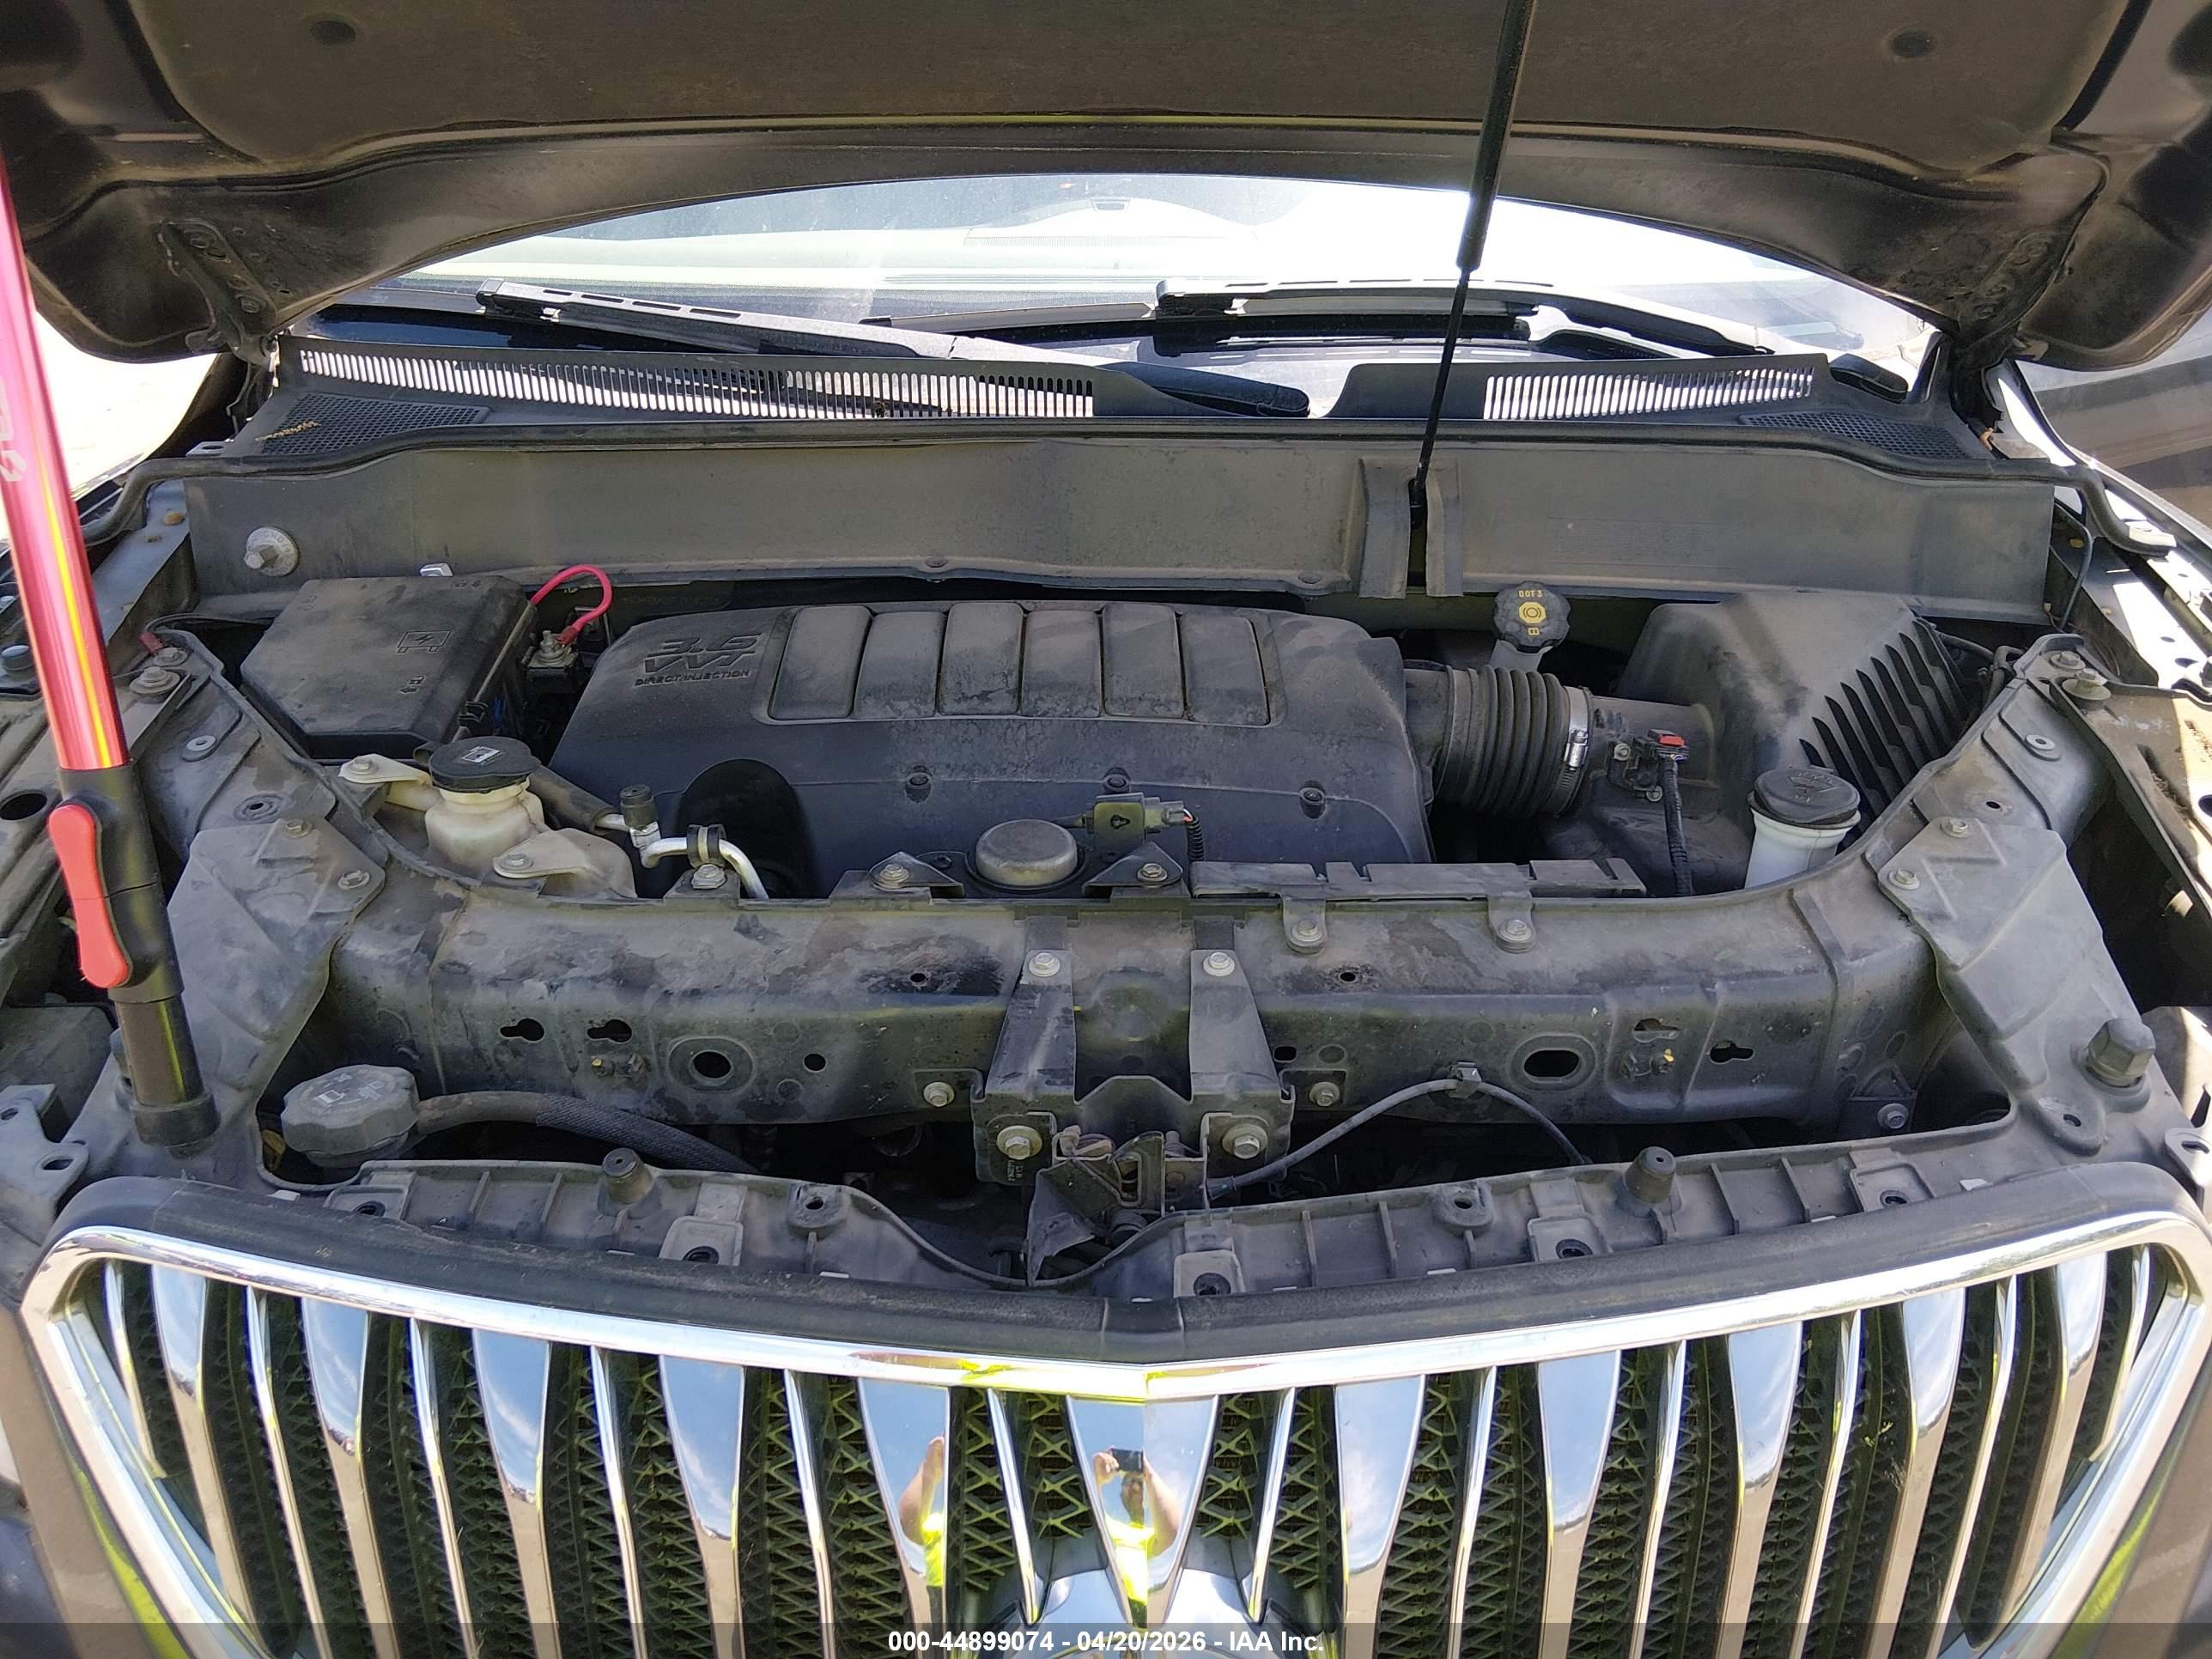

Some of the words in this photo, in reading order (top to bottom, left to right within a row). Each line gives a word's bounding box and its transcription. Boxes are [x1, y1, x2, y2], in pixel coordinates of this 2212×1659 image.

[661, 632, 763, 653] 3.6
[644, 651, 757, 674] VVT
[634, 674, 681, 687] DIRECT
[681, 669, 750, 684] INJECTION
